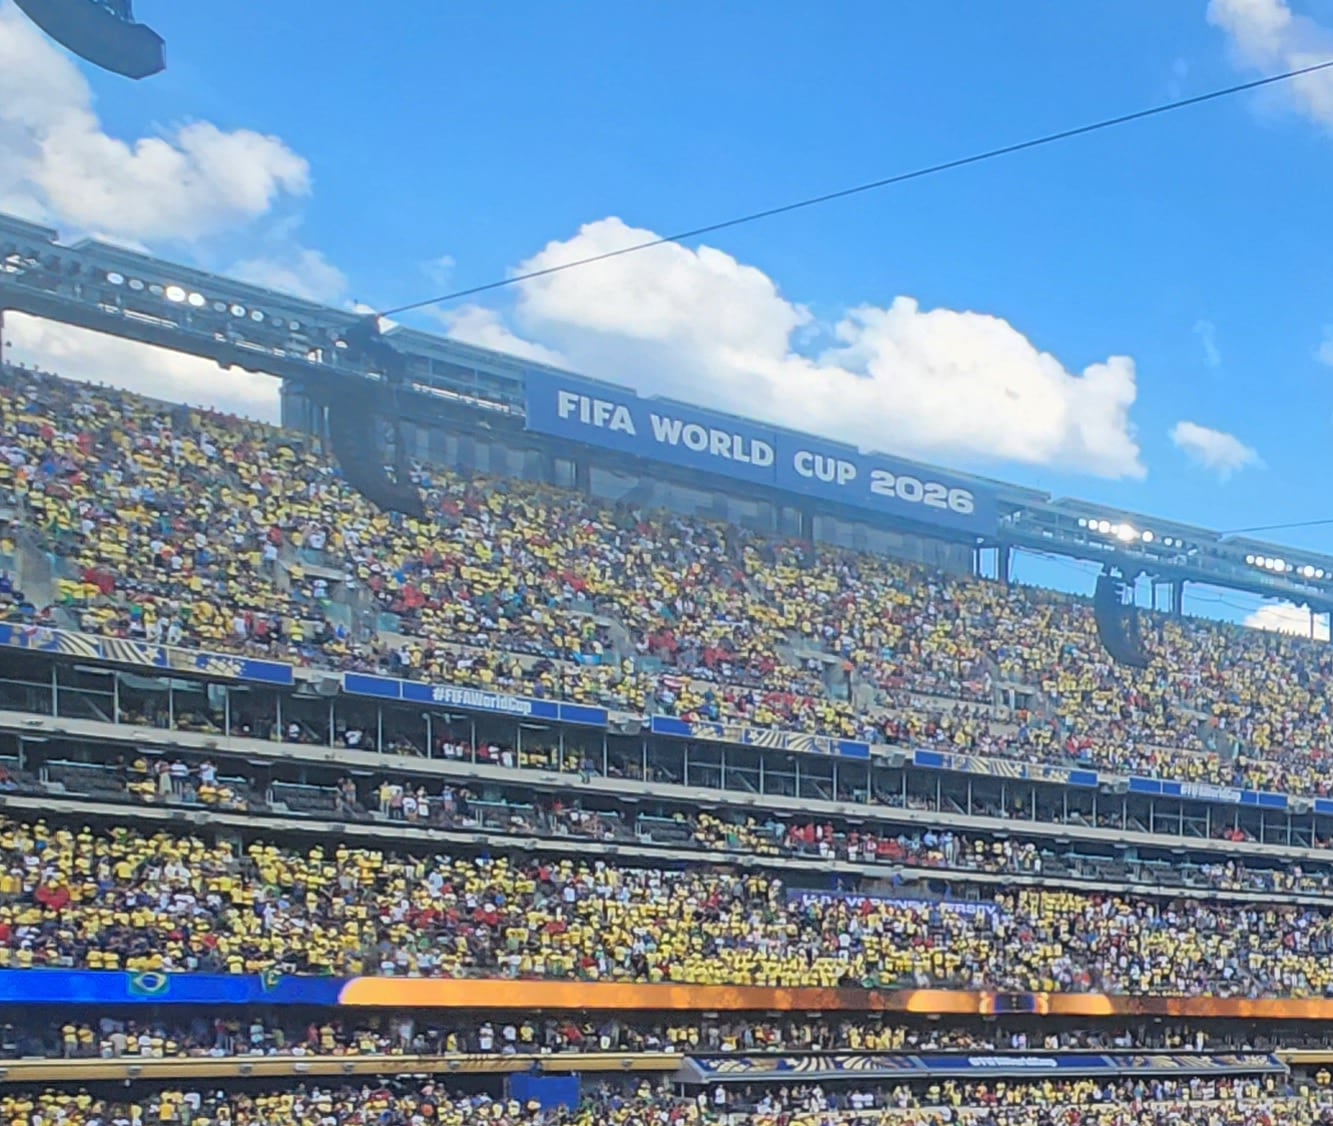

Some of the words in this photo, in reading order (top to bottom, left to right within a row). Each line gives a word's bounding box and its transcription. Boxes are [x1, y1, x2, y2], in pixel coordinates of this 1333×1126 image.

[557, 389, 635, 435] FIFA
[650, 413, 774, 467] WORLD
[793, 451, 857, 486] CUP
[869, 470, 975, 515] 2026
[432, 687, 532, 715] #FIFAWorldCup
